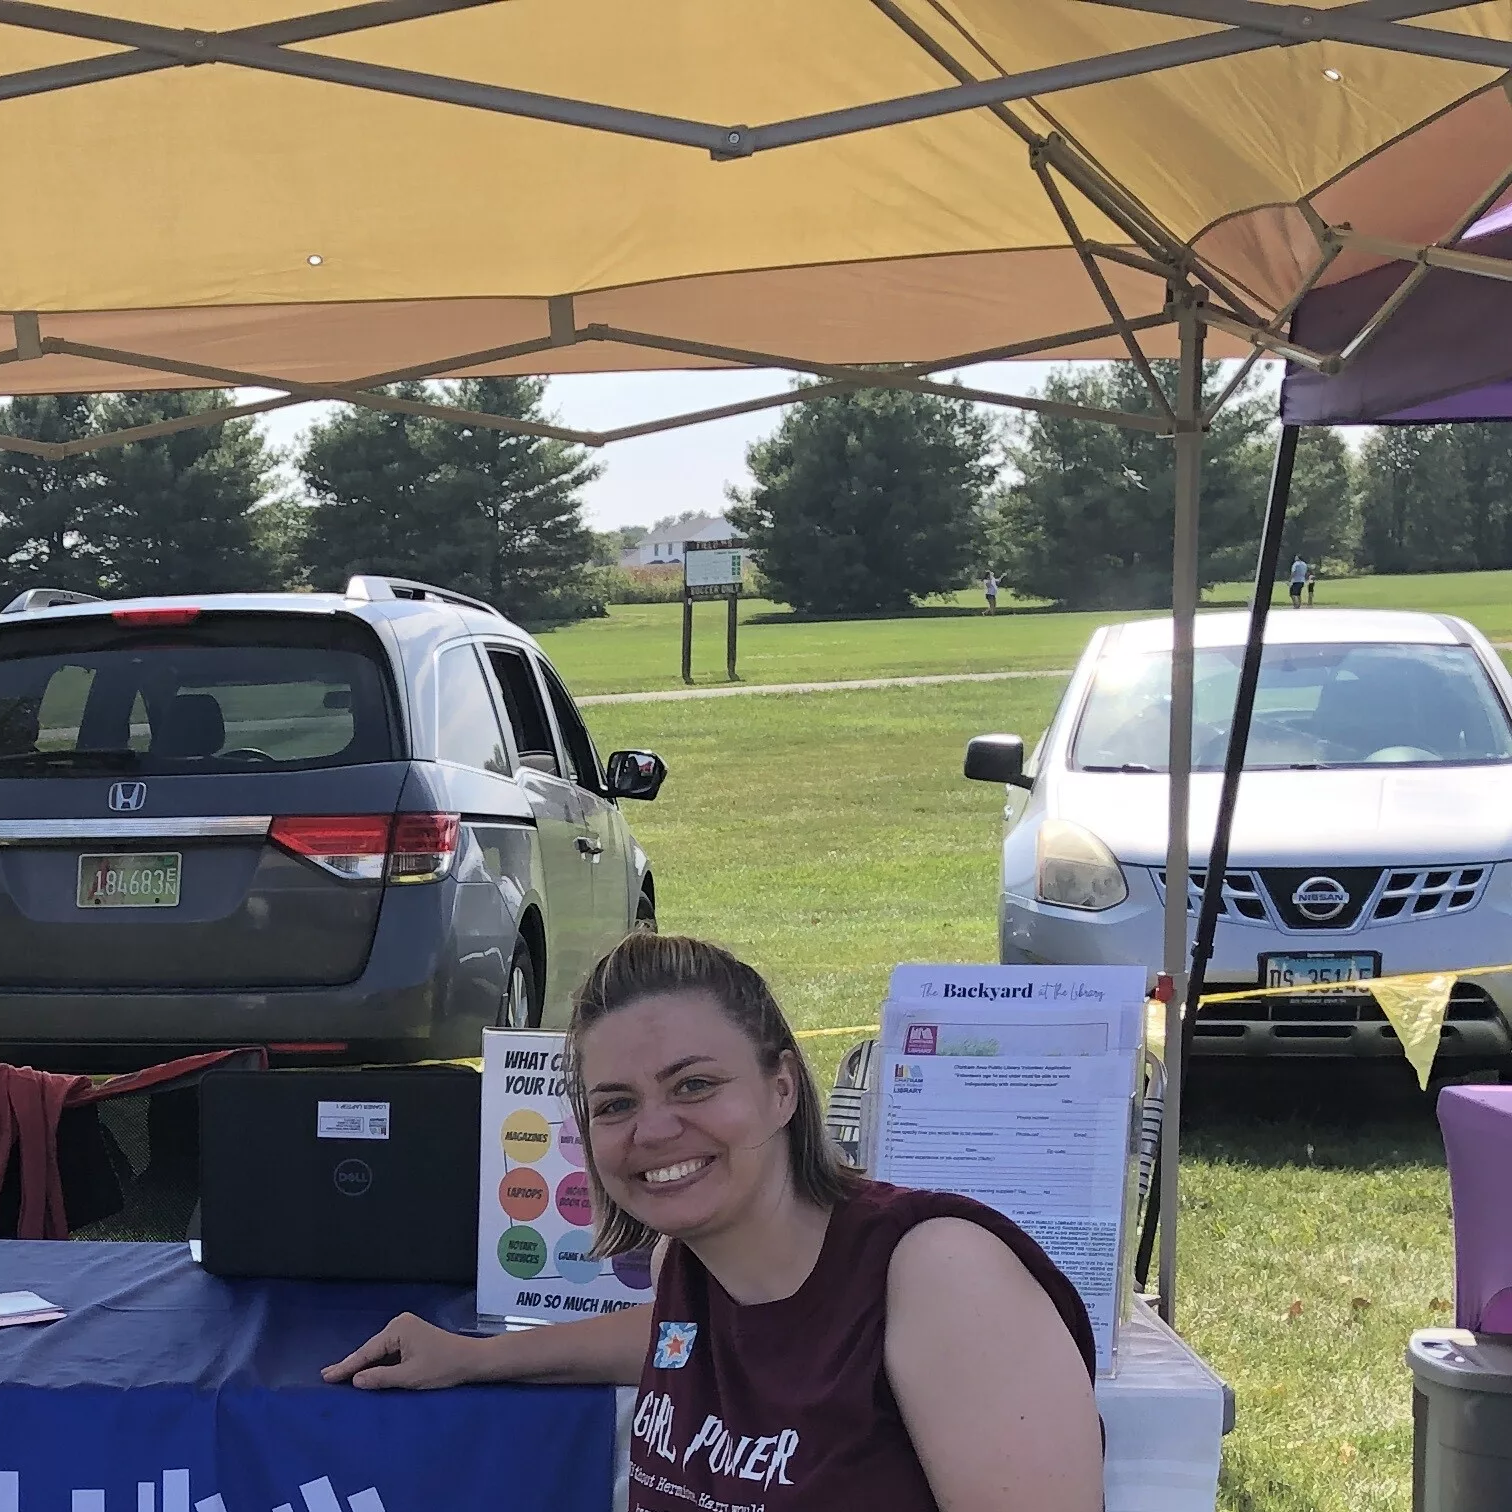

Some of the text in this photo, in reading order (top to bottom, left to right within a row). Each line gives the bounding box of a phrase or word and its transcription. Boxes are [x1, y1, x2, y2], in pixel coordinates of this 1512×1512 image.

[94, 869, 164, 896] 184683
[1298, 893, 1344, 902] NISSAN
[921, 983, 939, 998] The
[943, 983, 1033, 1001] Backyard
[1070, 983, 1105, 1001] Library
[505, 1051, 548, 1071] WHAT
[505, 1075, 543, 1097] YOUR
[505, 1132, 548, 1143] MAGAZINES
[507, 1187, 544, 1200] LAPTOPS
[508, 1240, 538, 1251] NOTARY
[506, 1252, 540, 1264] SERVICES
[516, 1292, 541, 1306] AND
[544, 1295, 561, 1309] SO
[563, 1296, 599, 1312] MUCH
[634, 1391, 799, 1492] GIRL POWER
